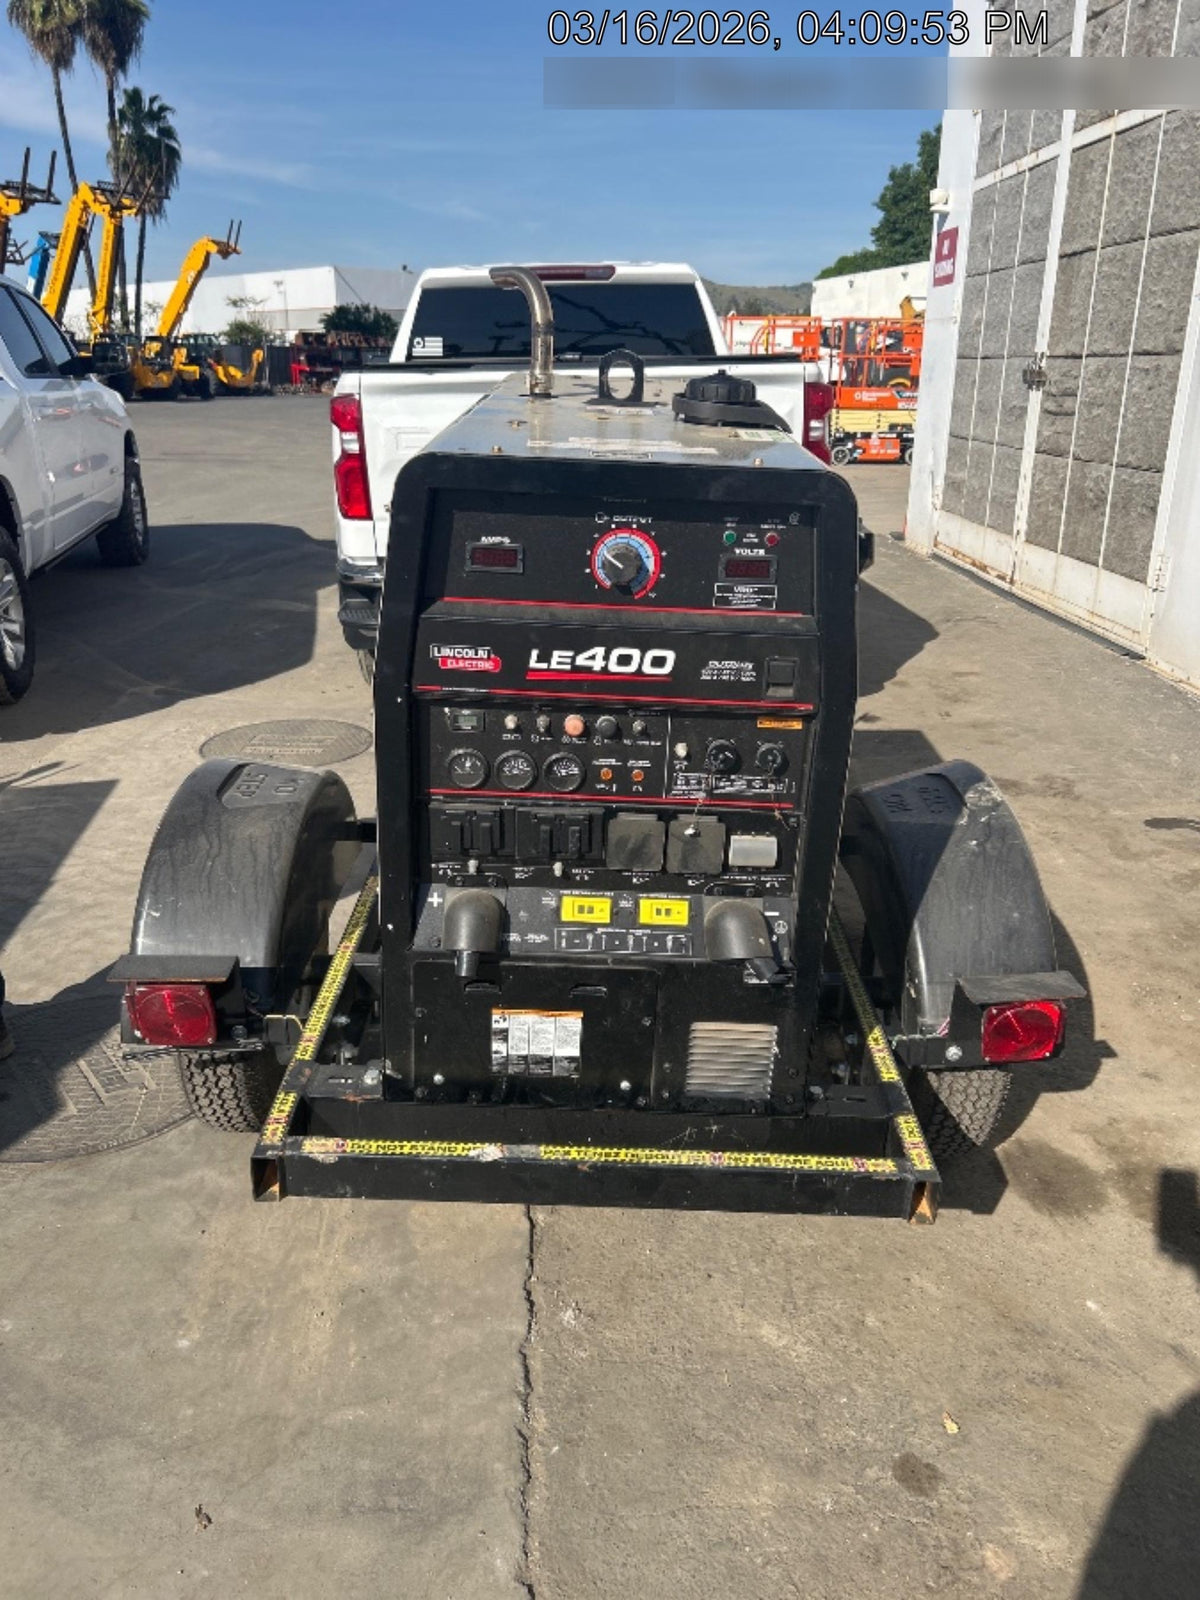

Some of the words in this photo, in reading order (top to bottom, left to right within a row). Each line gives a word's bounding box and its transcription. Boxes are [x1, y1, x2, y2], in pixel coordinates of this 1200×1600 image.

[612, 514, 653, 523] OUTPUT
[480, 536, 511, 544] AMPS
[734, 547, 766, 555] VOLTS
[433, 646, 488, 658] LINCOLN
[446, 659, 495, 670] ELECTRIC
[528, 646, 677, 675] LE400
[376, 1143, 407, 1151] NOT
[409, 1144, 458, 1153] STAND
